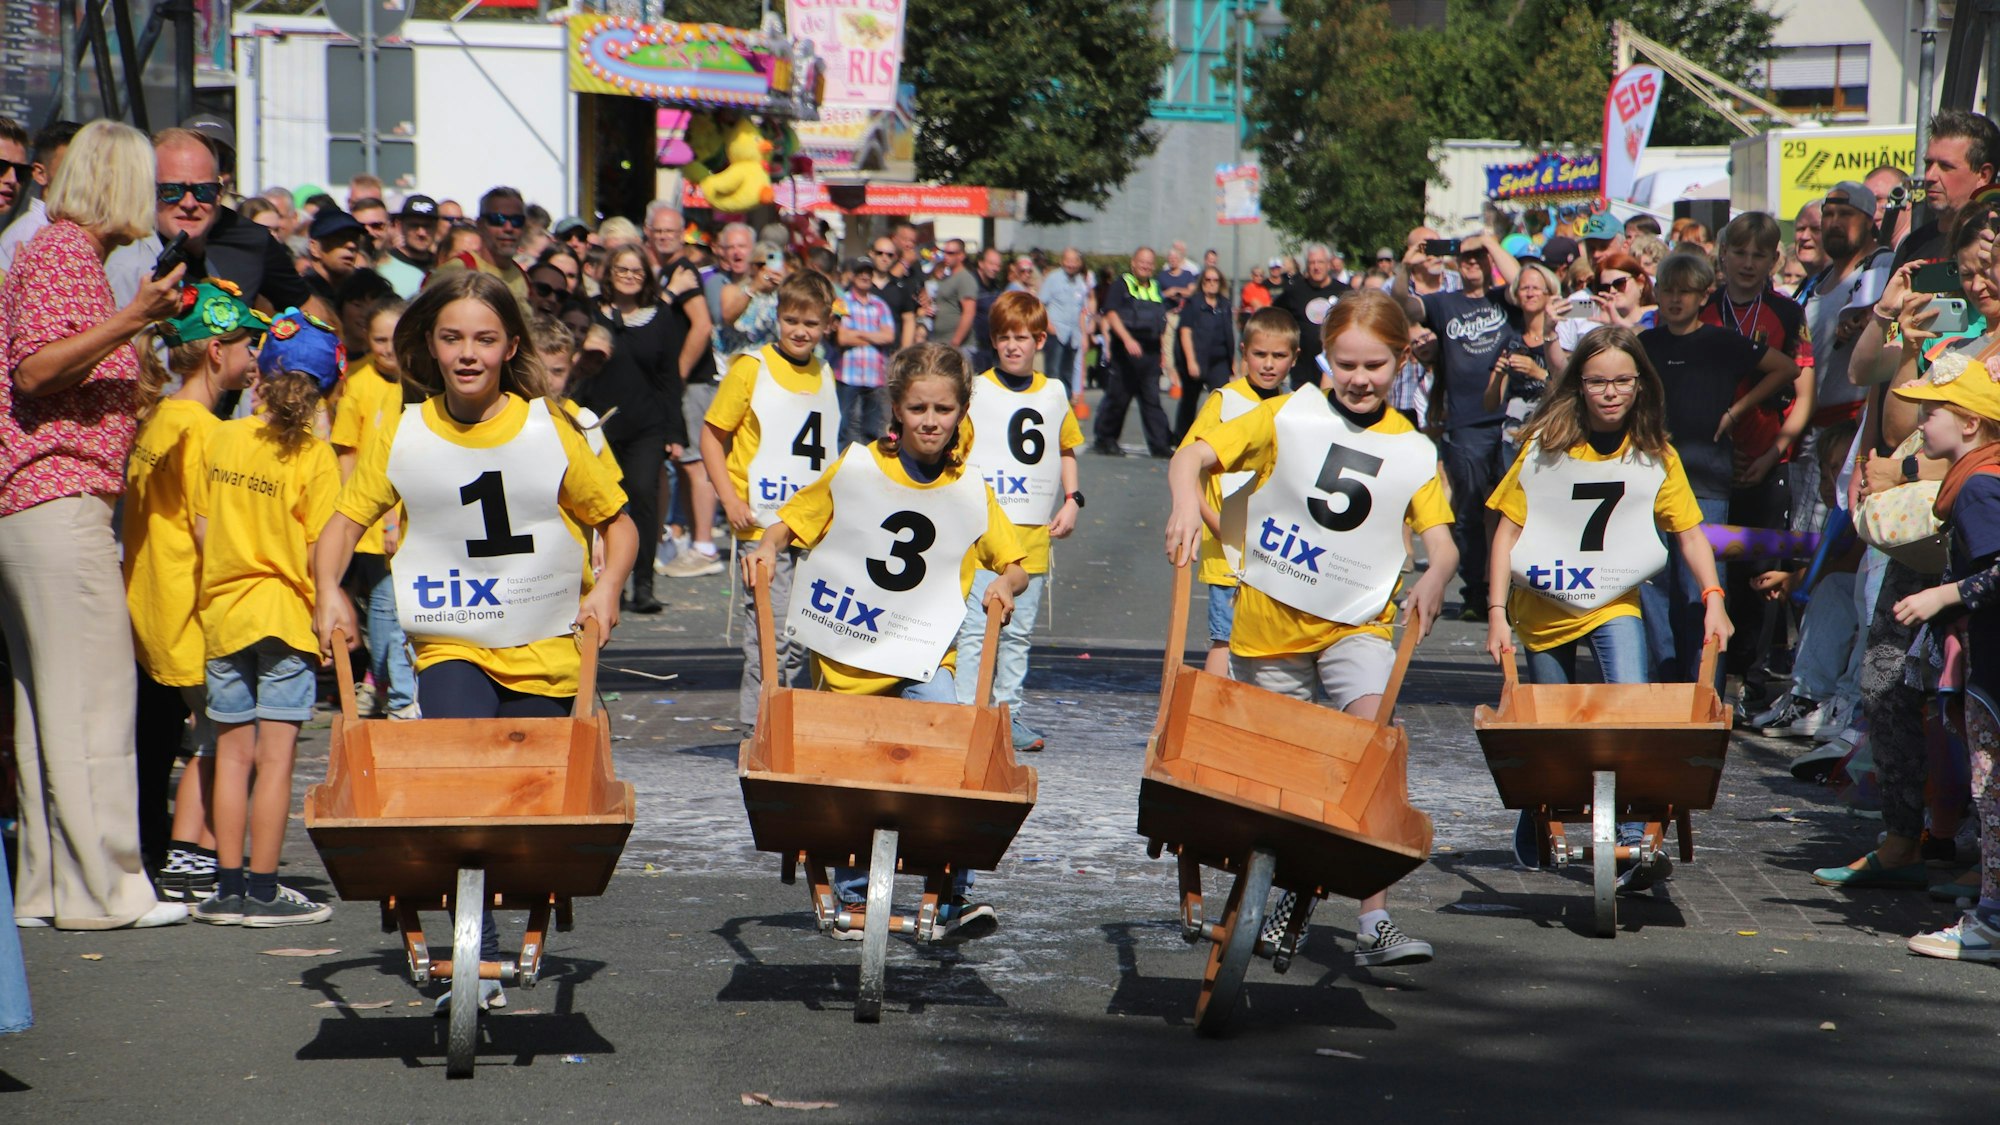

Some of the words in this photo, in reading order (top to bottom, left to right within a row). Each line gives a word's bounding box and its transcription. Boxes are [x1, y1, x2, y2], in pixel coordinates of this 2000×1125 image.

[1613, 73, 1656, 124] EIS
[1784, 141, 1807, 158] 29
[791, 410, 826, 472] 4
[1007, 407, 1045, 465] 6
[247, 472, 279, 498] dabei
[1307, 442, 1384, 532] 5
[459, 470, 535, 558] 1
[996, 496, 1030, 505] a@home
[1571, 481, 1625, 552] 7
[866, 510, 936, 592] 3
[1258, 516, 1327, 574] tix
[1252, 548, 1318, 586] media@home
[1328, 561, 1349, 573] home
[1331, 552, 1372, 571] faszination
[1526, 560, 1595, 591] tix
[413, 569, 502, 609] tix
[506, 572, 554, 585] faszination
[507, 587, 532, 595] home
[508, 588, 568, 606] entertainment
[810, 578, 885, 633] tix
[1531, 589, 1596, 601] dia@home
[414, 609, 505, 624] media@home
[801, 606, 877, 644] media@home
[887, 620, 909, 632] home
[890, 611, 932, 628] faszination
[884, 629, 936, 646] entertainment
